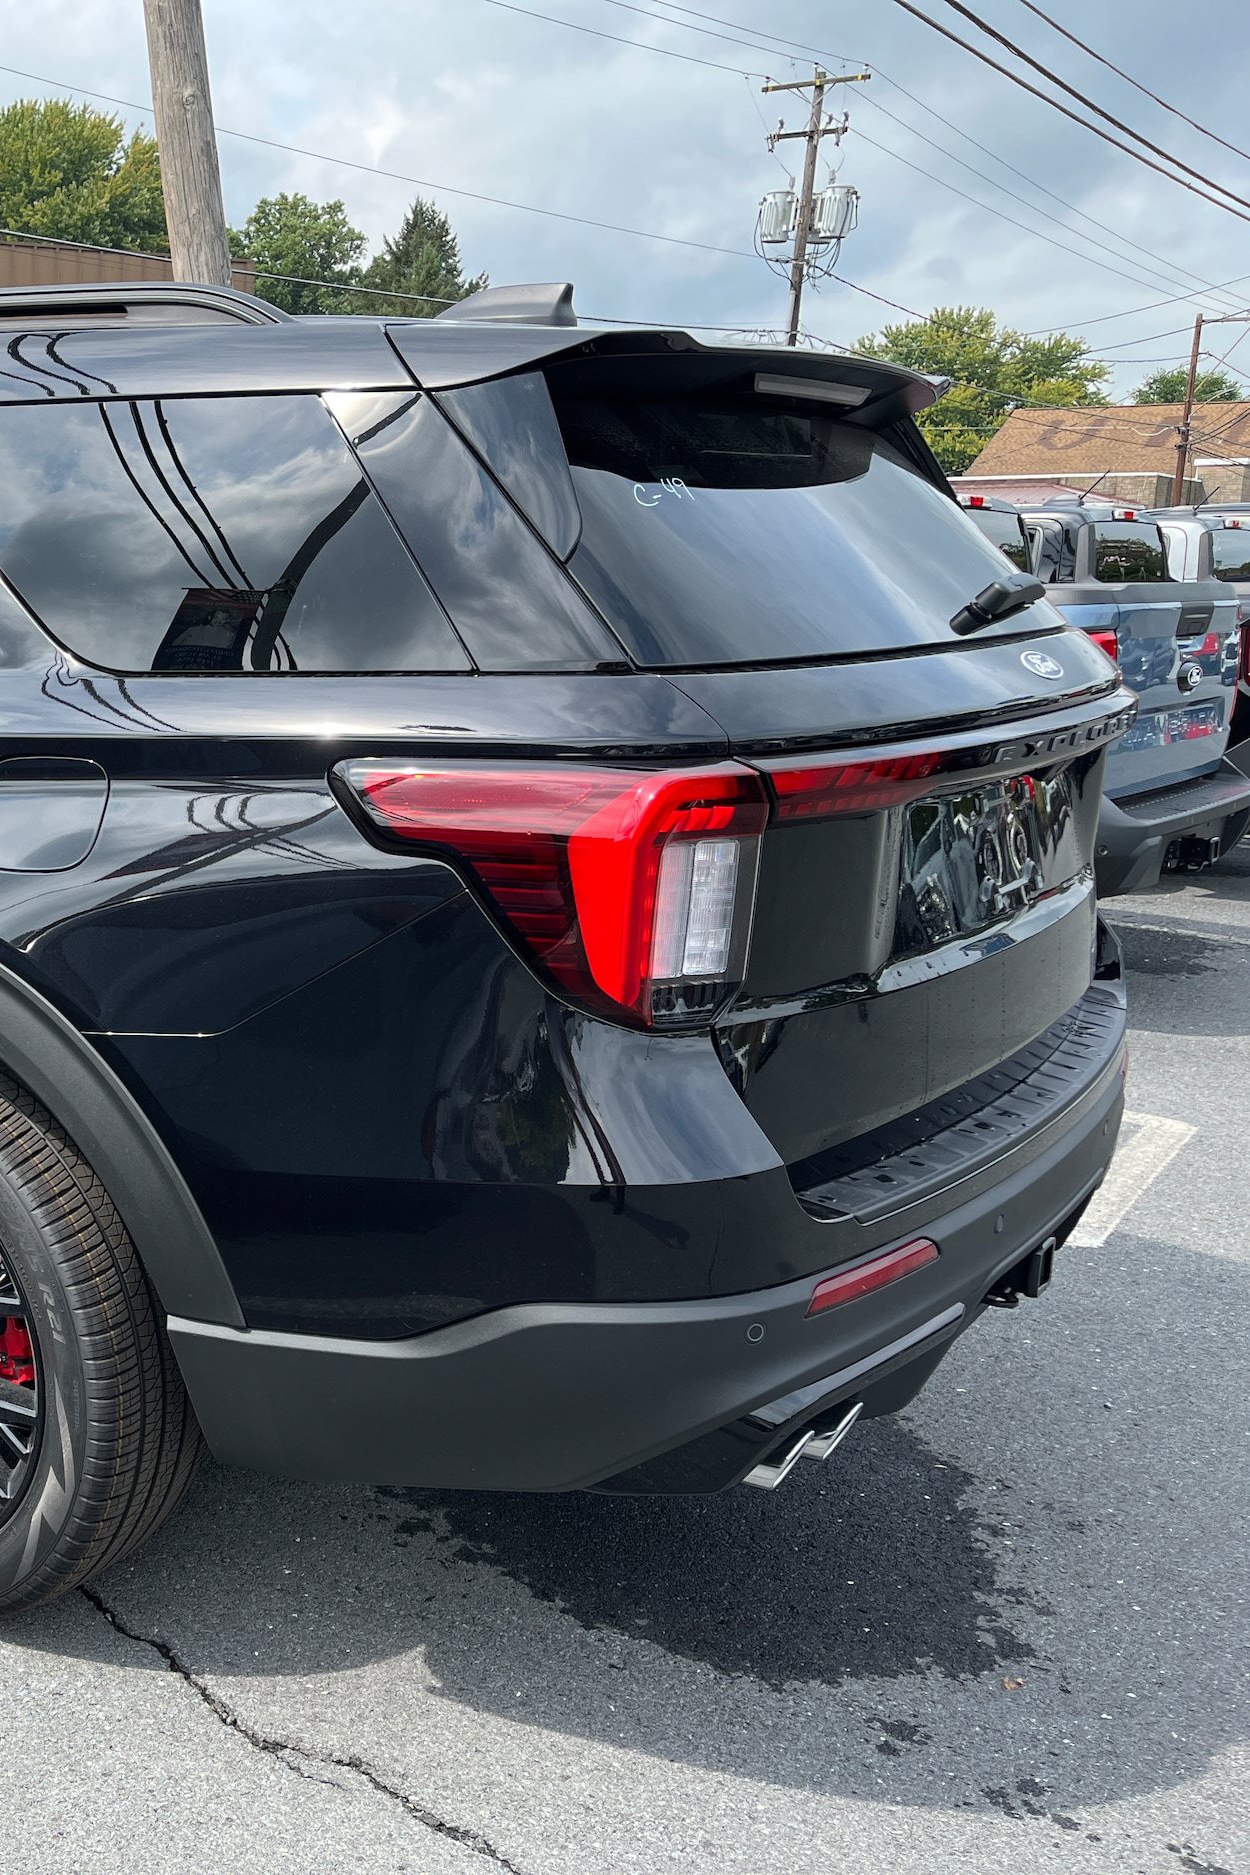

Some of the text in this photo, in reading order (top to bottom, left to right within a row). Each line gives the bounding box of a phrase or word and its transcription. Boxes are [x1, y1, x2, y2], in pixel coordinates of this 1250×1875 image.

[634, 477, 695, 507] C-49
[1023, 652, 1062, 678] Ford
[38, 1282, 66, 1345] R21
